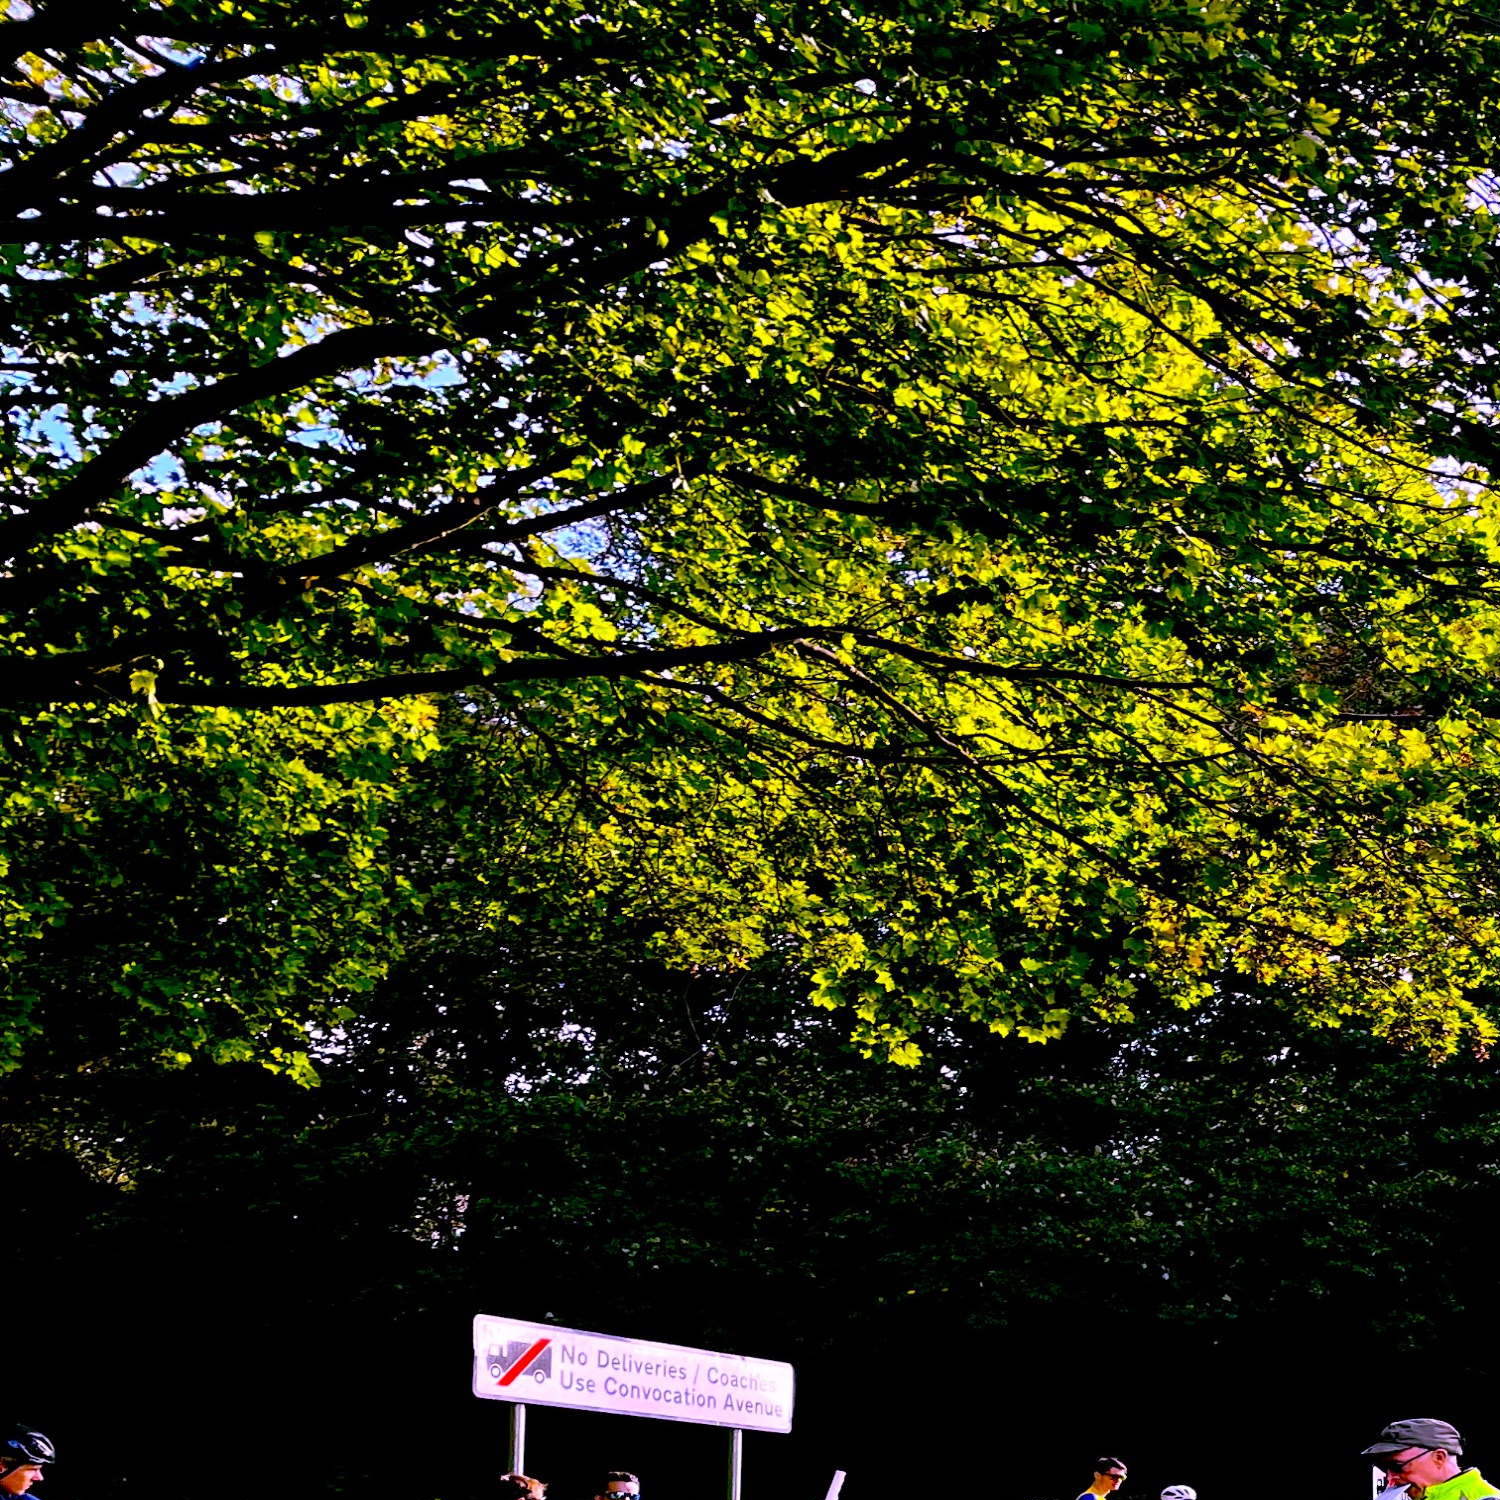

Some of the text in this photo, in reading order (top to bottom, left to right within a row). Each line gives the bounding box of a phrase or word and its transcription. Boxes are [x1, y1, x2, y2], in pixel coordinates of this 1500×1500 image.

[561, 1344, 588, 1366] No
[597, 1349, 687, 1380] Deliveries
[707, 1366, 777, 1393] Coaches
[560, 1369, 783, 1417] Use Convocation Avenue
